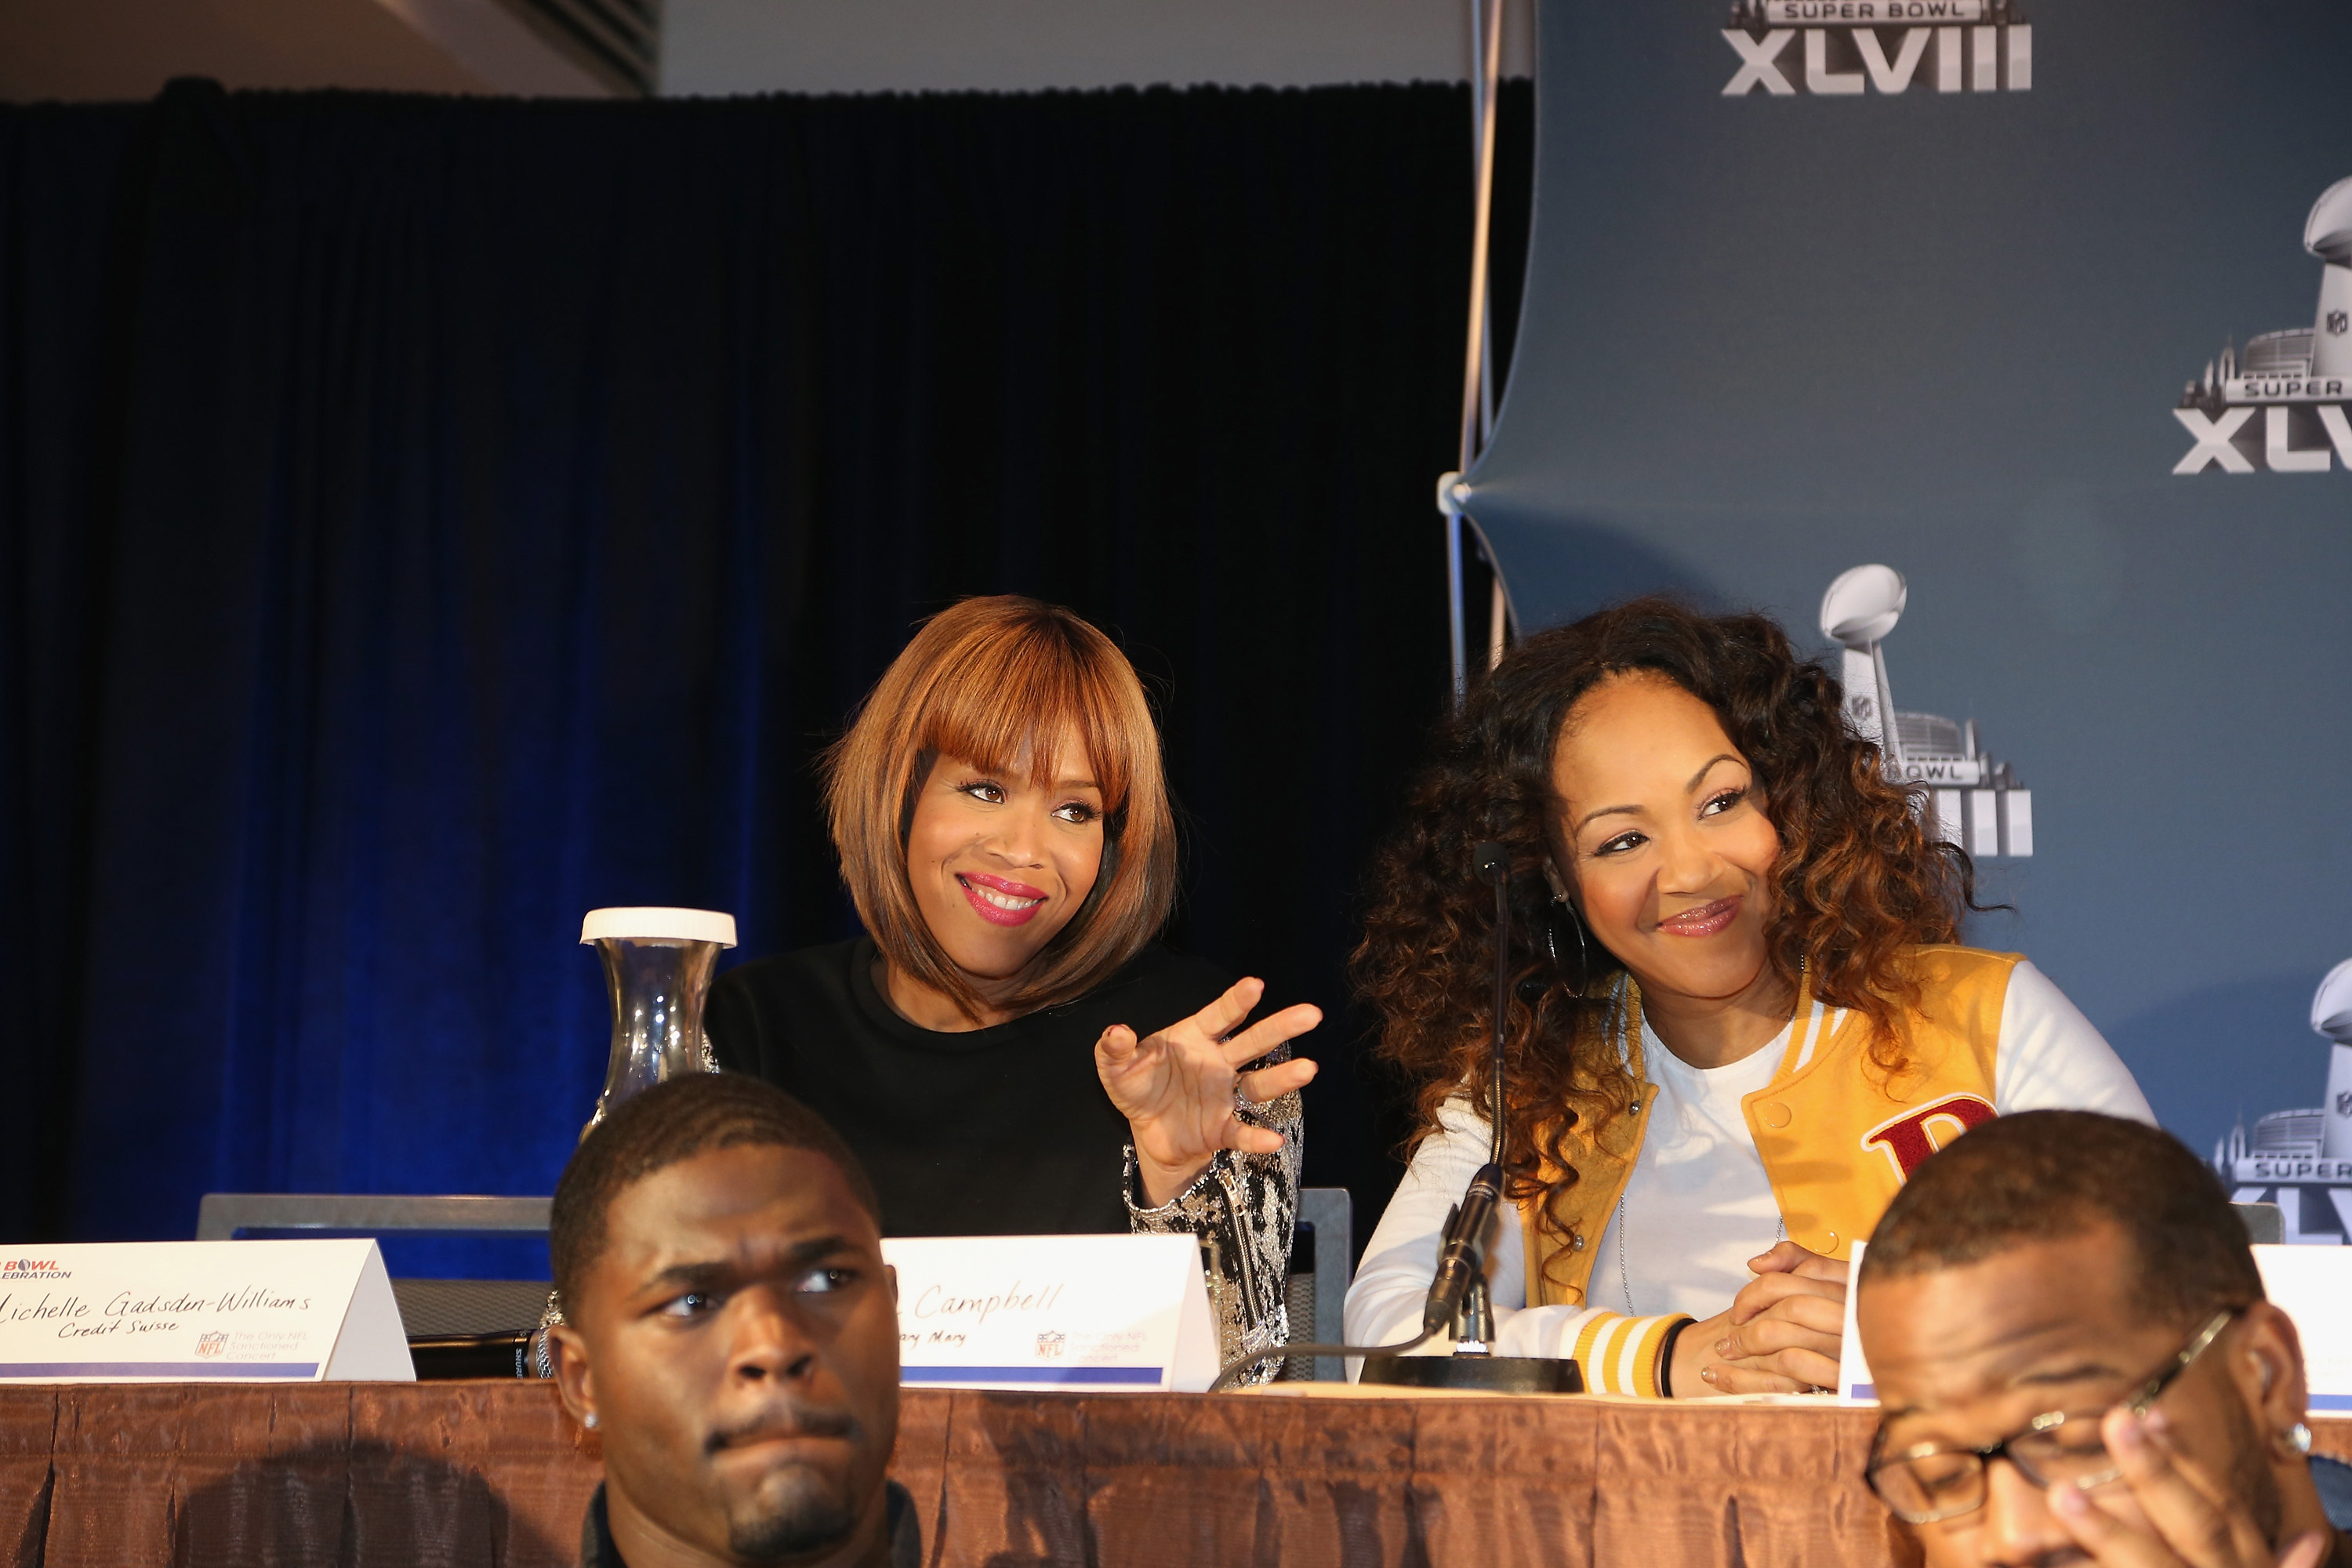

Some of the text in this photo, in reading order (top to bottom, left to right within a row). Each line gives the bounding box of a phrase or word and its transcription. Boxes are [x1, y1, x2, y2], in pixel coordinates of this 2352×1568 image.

[1784, 1, 1965, 19] SUPER BOWL
[1720, 24, 2032, 96] XLVIII
[2244, 379, 2343, 397] SUPER
[1905, 764, 1964, 779] OWL
[2255, 1162, 2352, 1177] SUPER
[915, 1279, 1065, 1326] Campbell
[58, 1319, 180, 1338] Credit Suisse
[234, 1330, 307, 1342] The Only NFL
[1127, 1331, 1148, 1341] NFL
[230, 1341, 299, 1351] Sanctioned
[899, 1330, 967, 1349] ary Mary
[198, 1341, 221, 1355] NFL
[1038, 1343, 1062, 1357] NFL
[226, 1352, 276, 1360] Concert
